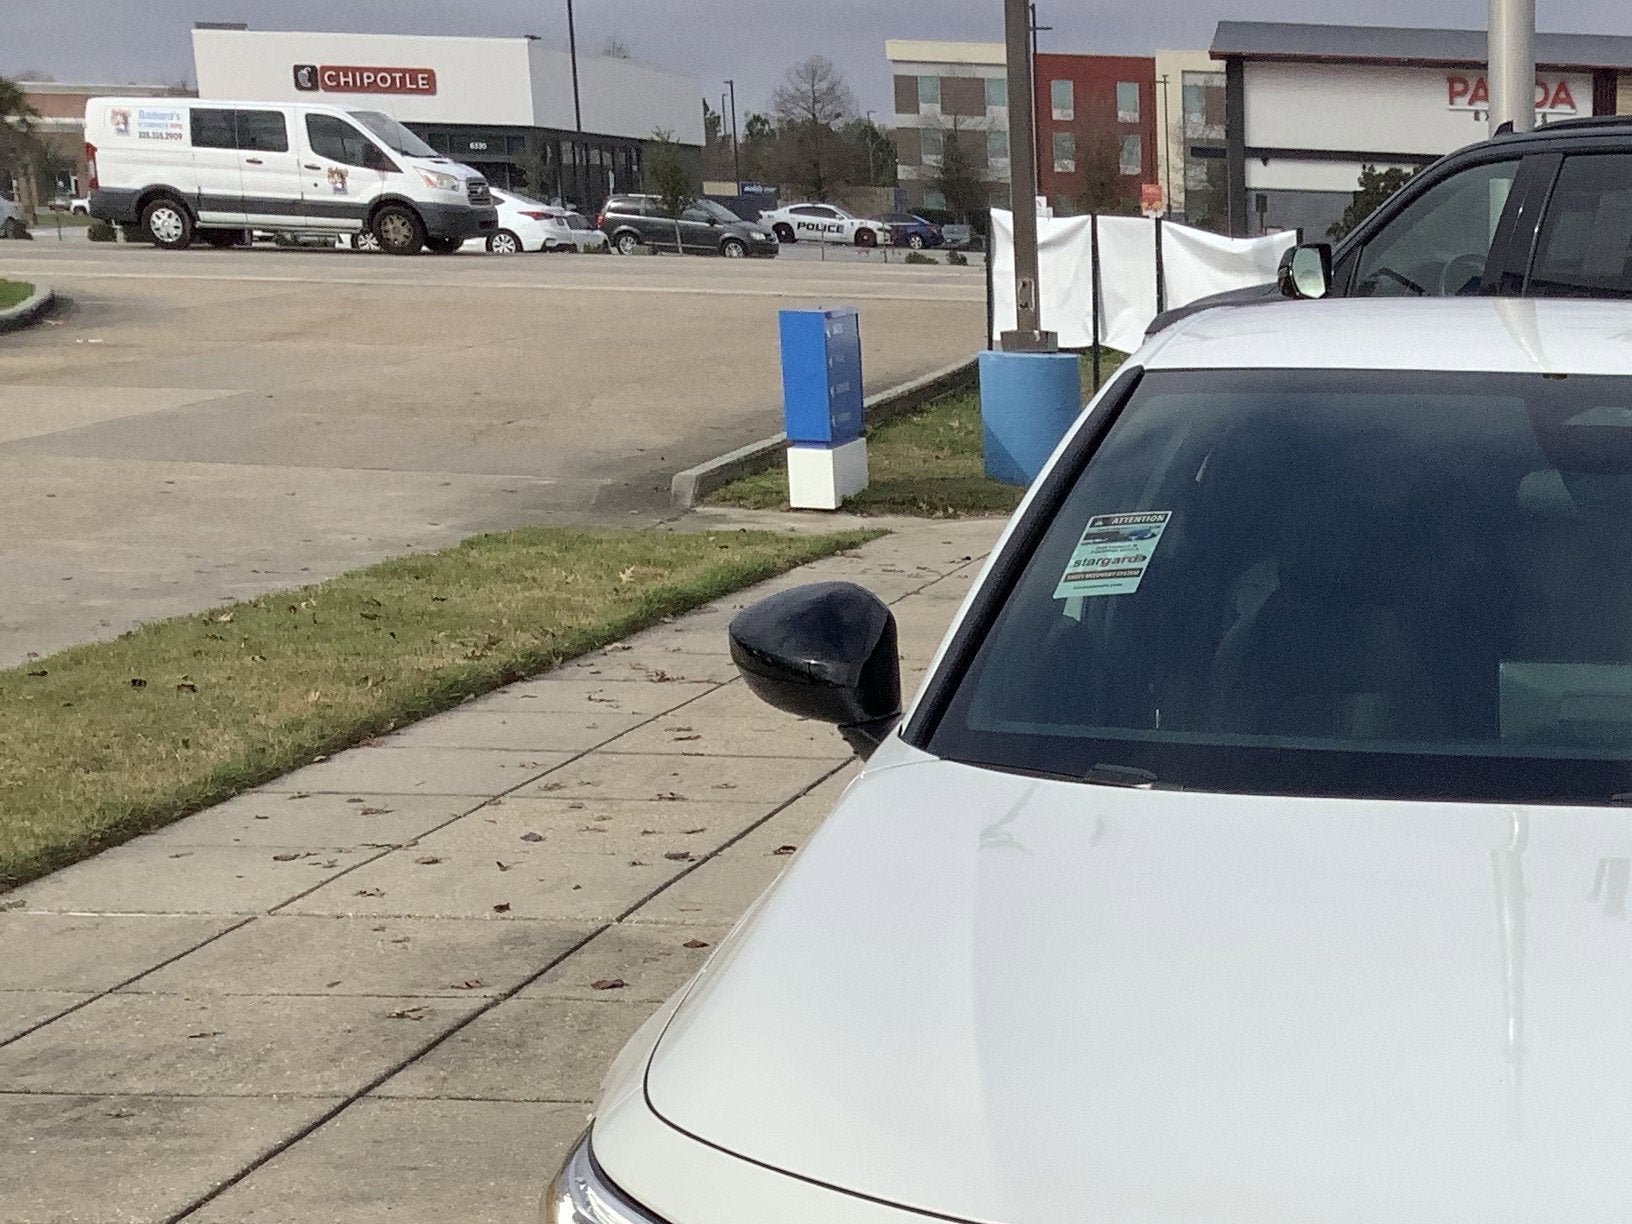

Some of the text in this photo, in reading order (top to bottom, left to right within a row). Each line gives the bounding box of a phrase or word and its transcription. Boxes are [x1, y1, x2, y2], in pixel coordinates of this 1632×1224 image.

[323, 70, 430, 90] CHIPOTLE
[1446, 75, 1577, 110] PADA
[797, 221, 844, 234] POLICE
[1111, 514, 1165, 525] ATTENTION
[1073, 554, 1139, 568] stargard
